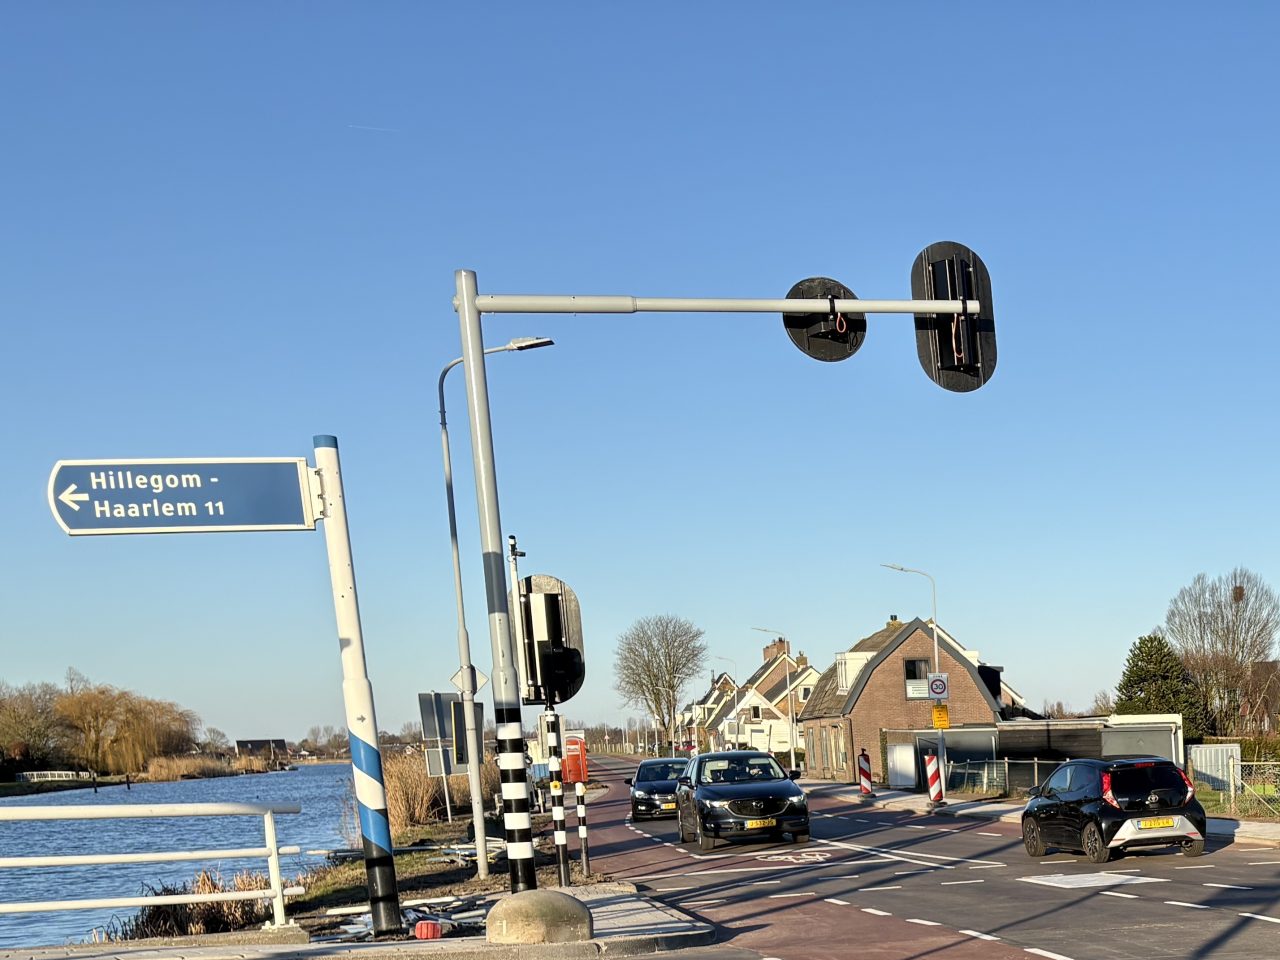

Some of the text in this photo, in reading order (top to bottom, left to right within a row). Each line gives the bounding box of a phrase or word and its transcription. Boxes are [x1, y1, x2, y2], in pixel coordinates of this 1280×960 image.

[90, 471, 202, 493] Hillegom
[94, 500, 225, 518] Haarlem 11
